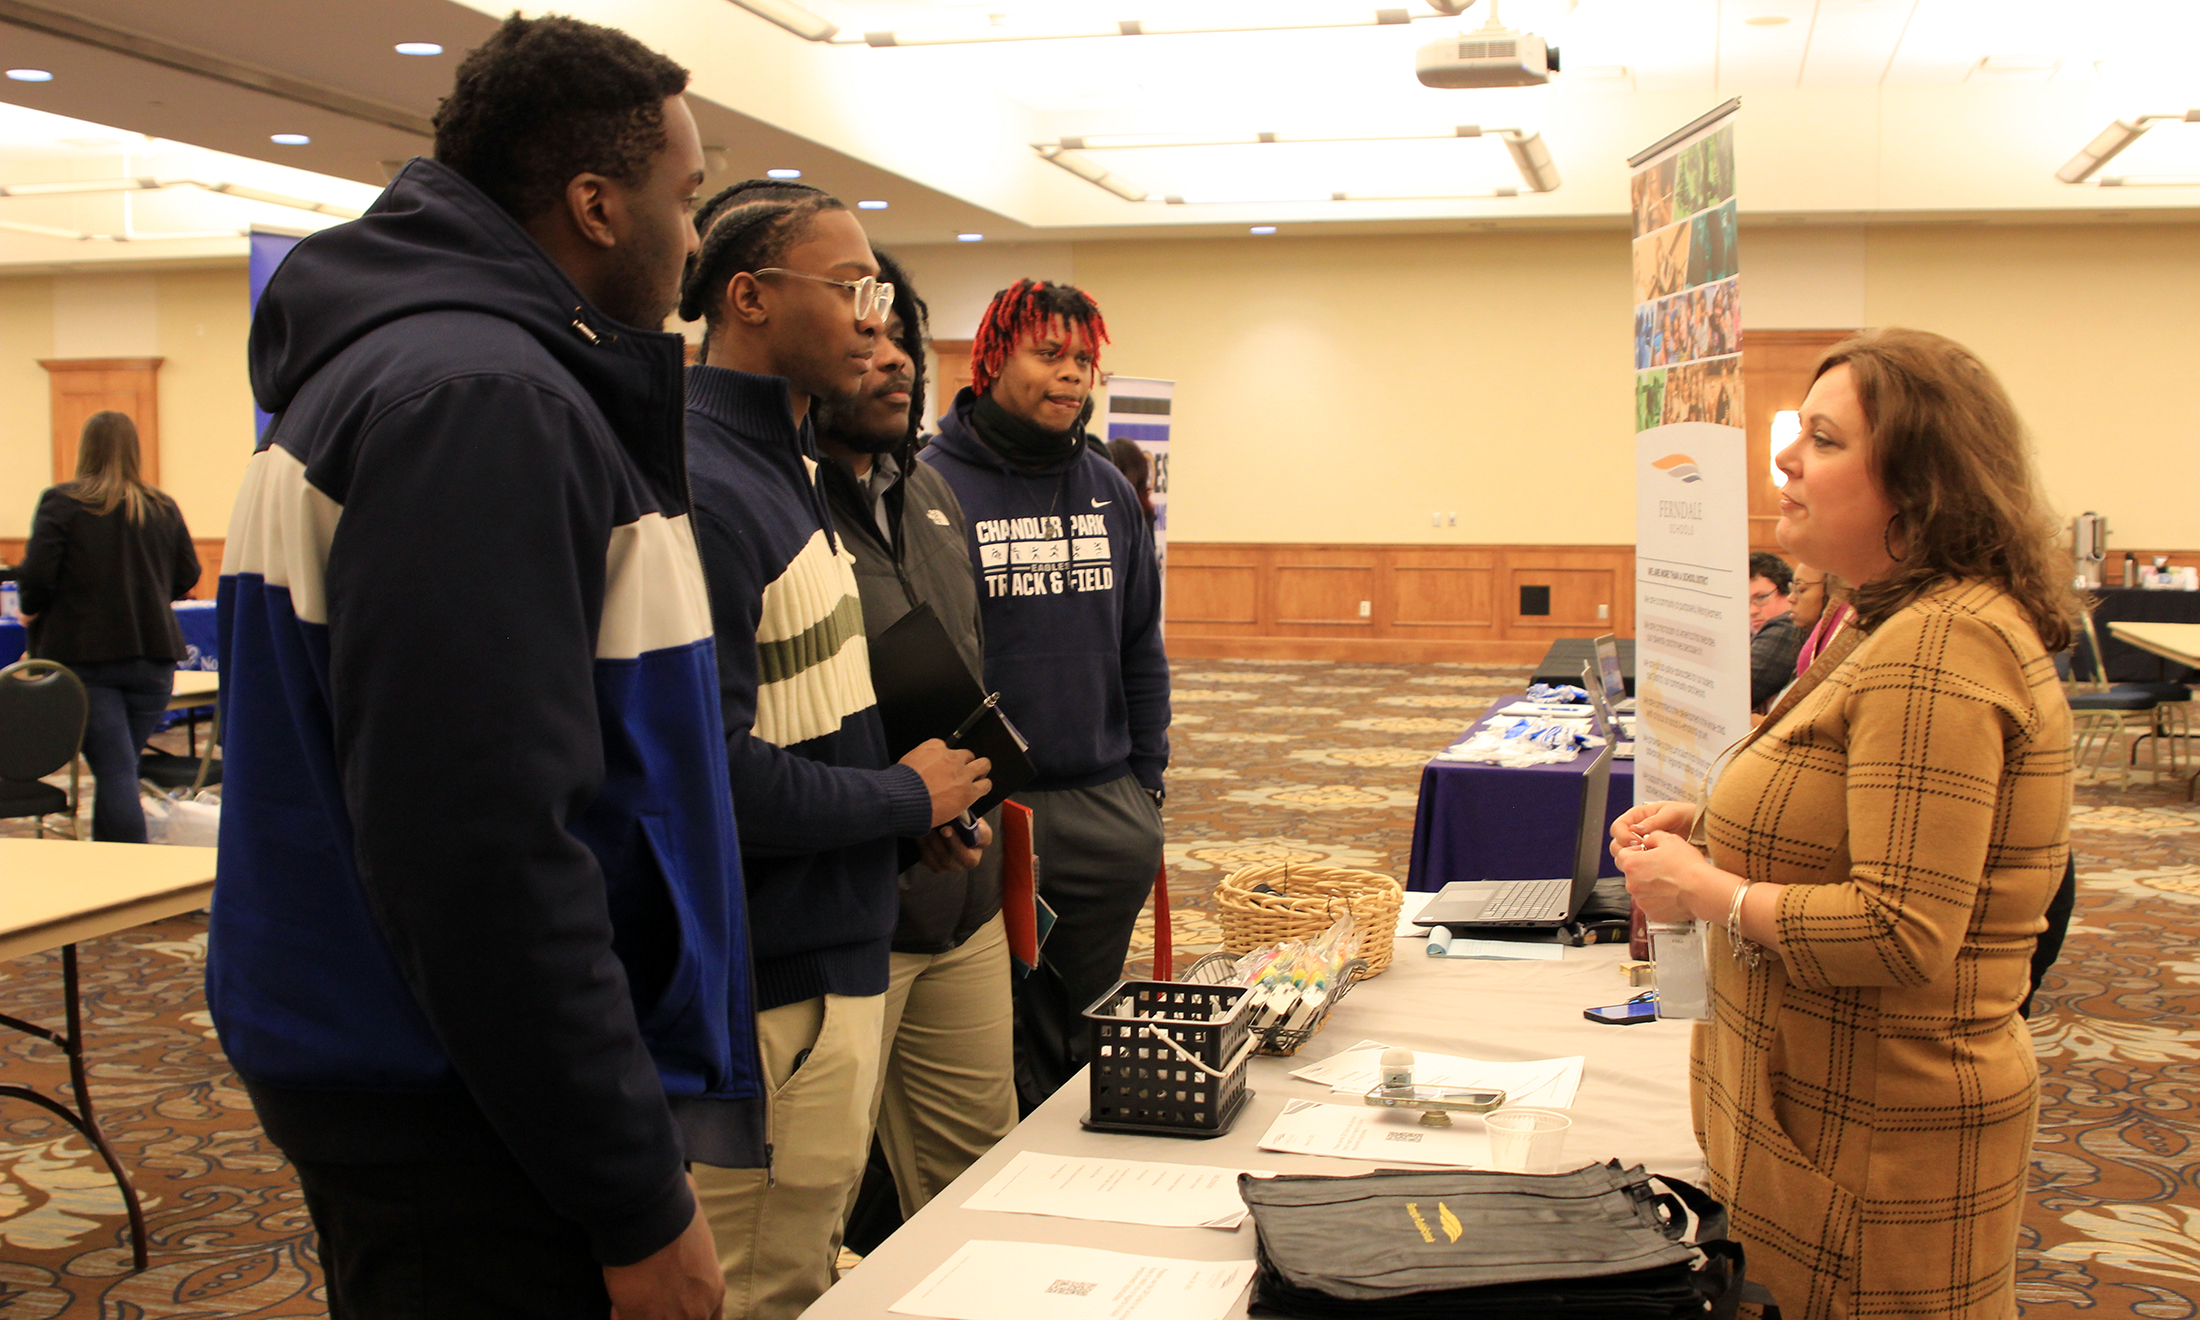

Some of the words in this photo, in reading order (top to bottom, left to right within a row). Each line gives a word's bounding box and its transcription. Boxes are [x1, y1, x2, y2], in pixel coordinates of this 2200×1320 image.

[1659, 500, 1702, 520] FERNDALE
[975, 515, 1064, 544] CHANDLER
[1069, 514, 1108, 537] PARK
[1030, 562, 1071, 572] EAGLES
[984, 572, 1048, 597] TRACK
[1049, 571, 1064, 594] &
[1066, 567, 1114, 592] FIELD
